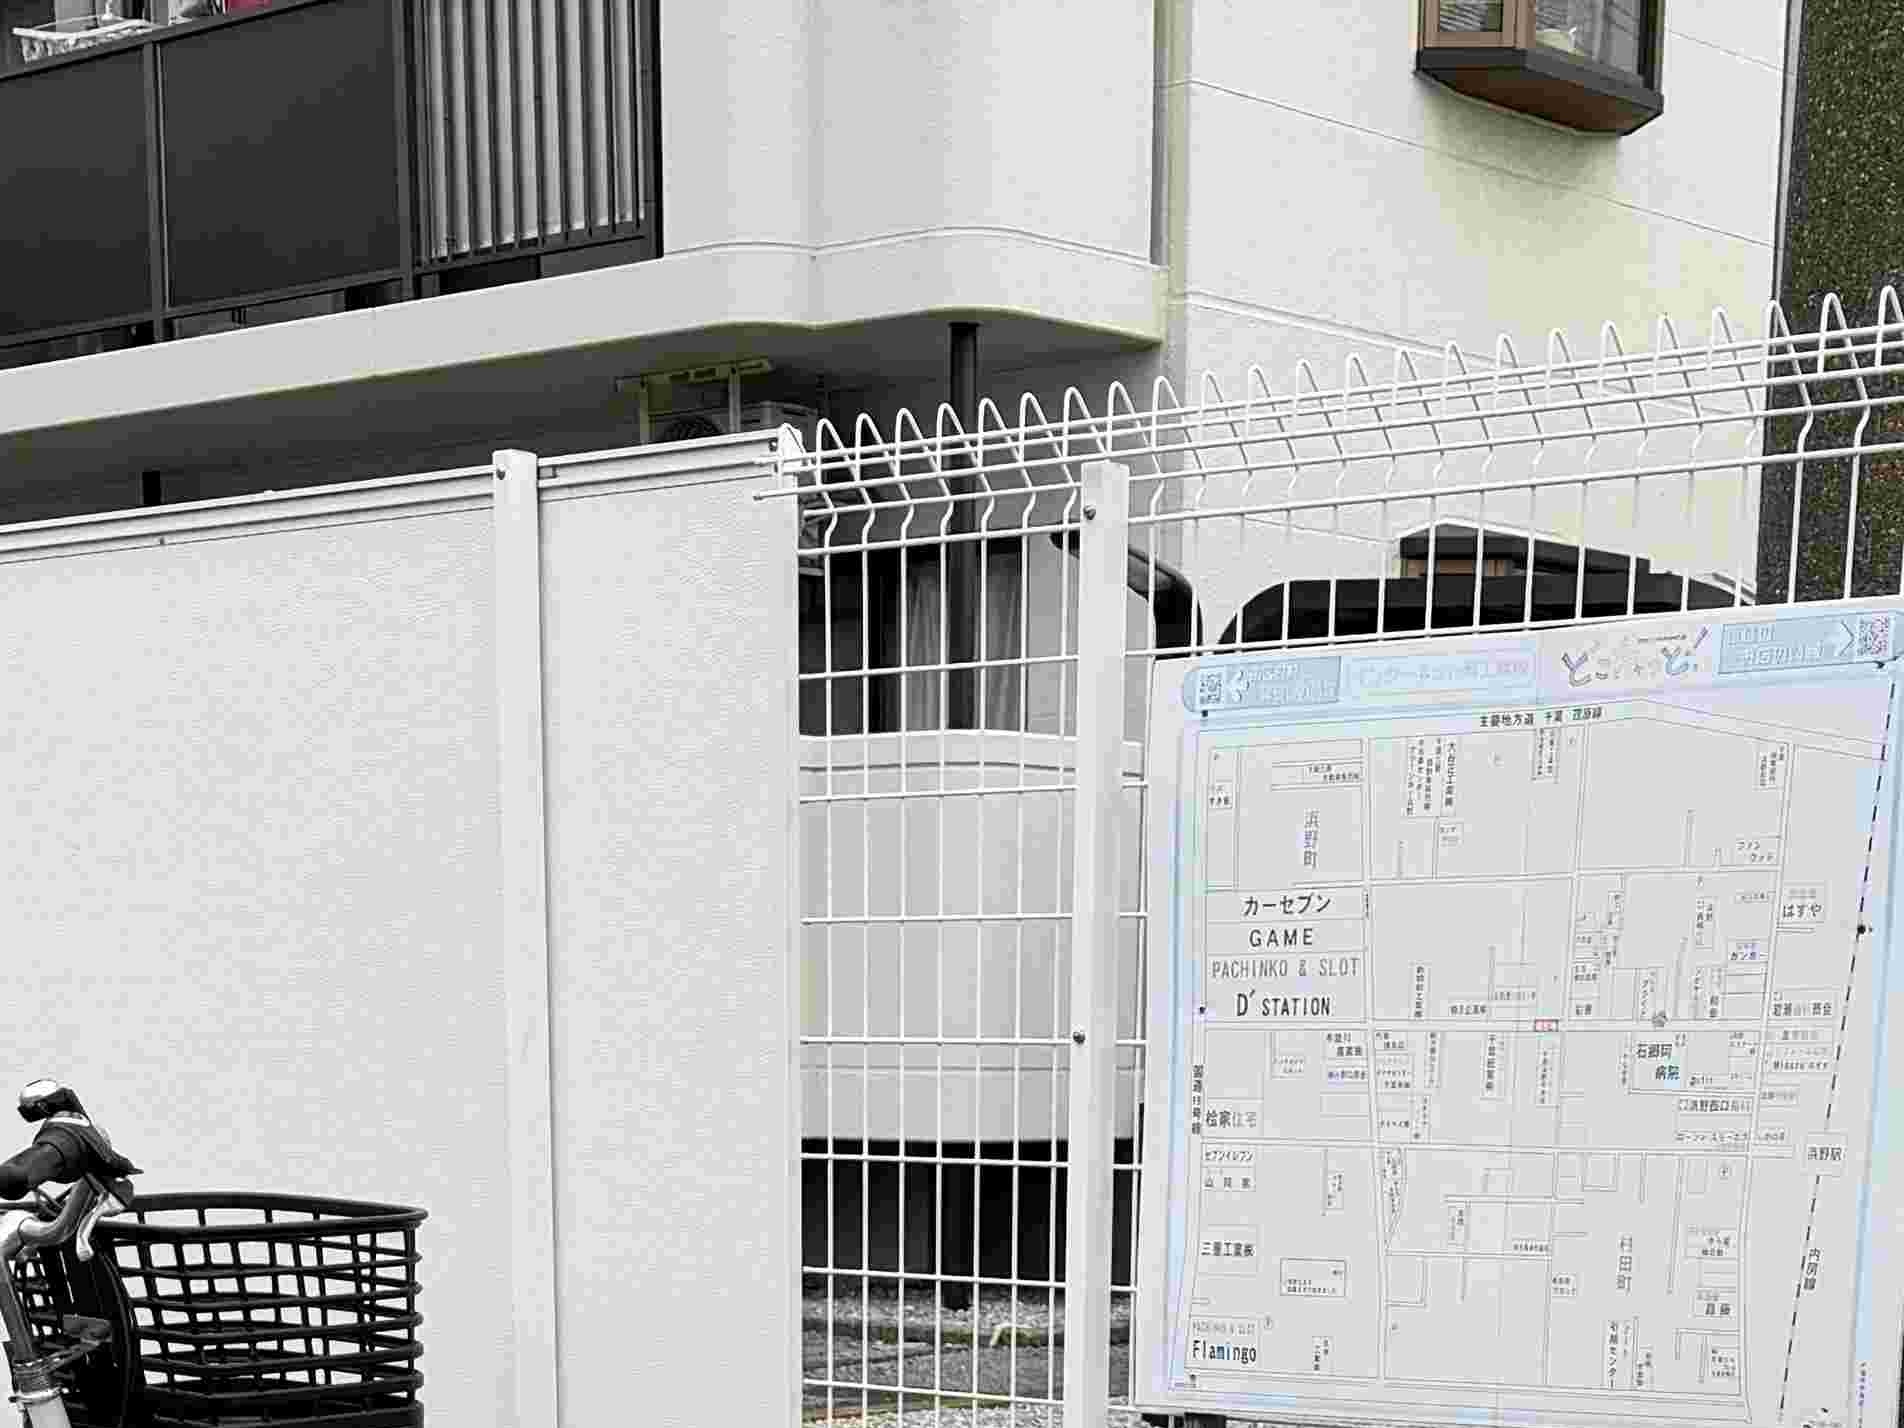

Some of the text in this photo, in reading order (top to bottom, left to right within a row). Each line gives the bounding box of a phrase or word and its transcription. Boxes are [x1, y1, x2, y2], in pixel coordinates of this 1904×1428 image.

[1304, 808, 1319, 869] 浜野町
[1243, 892, 1331, 916] カーセブン
[1783, 904, 1822, 917] はすや
[1249, 928, 1314, 947] GAME
[1211, 957, 1360, 979] PACHINKO & SLOT
[1262, 997, 1331, 1017] STATION
[1655, 1064, 1681, 1080] 病院
[1192, 1339, 1257, 1364] Flamingo
